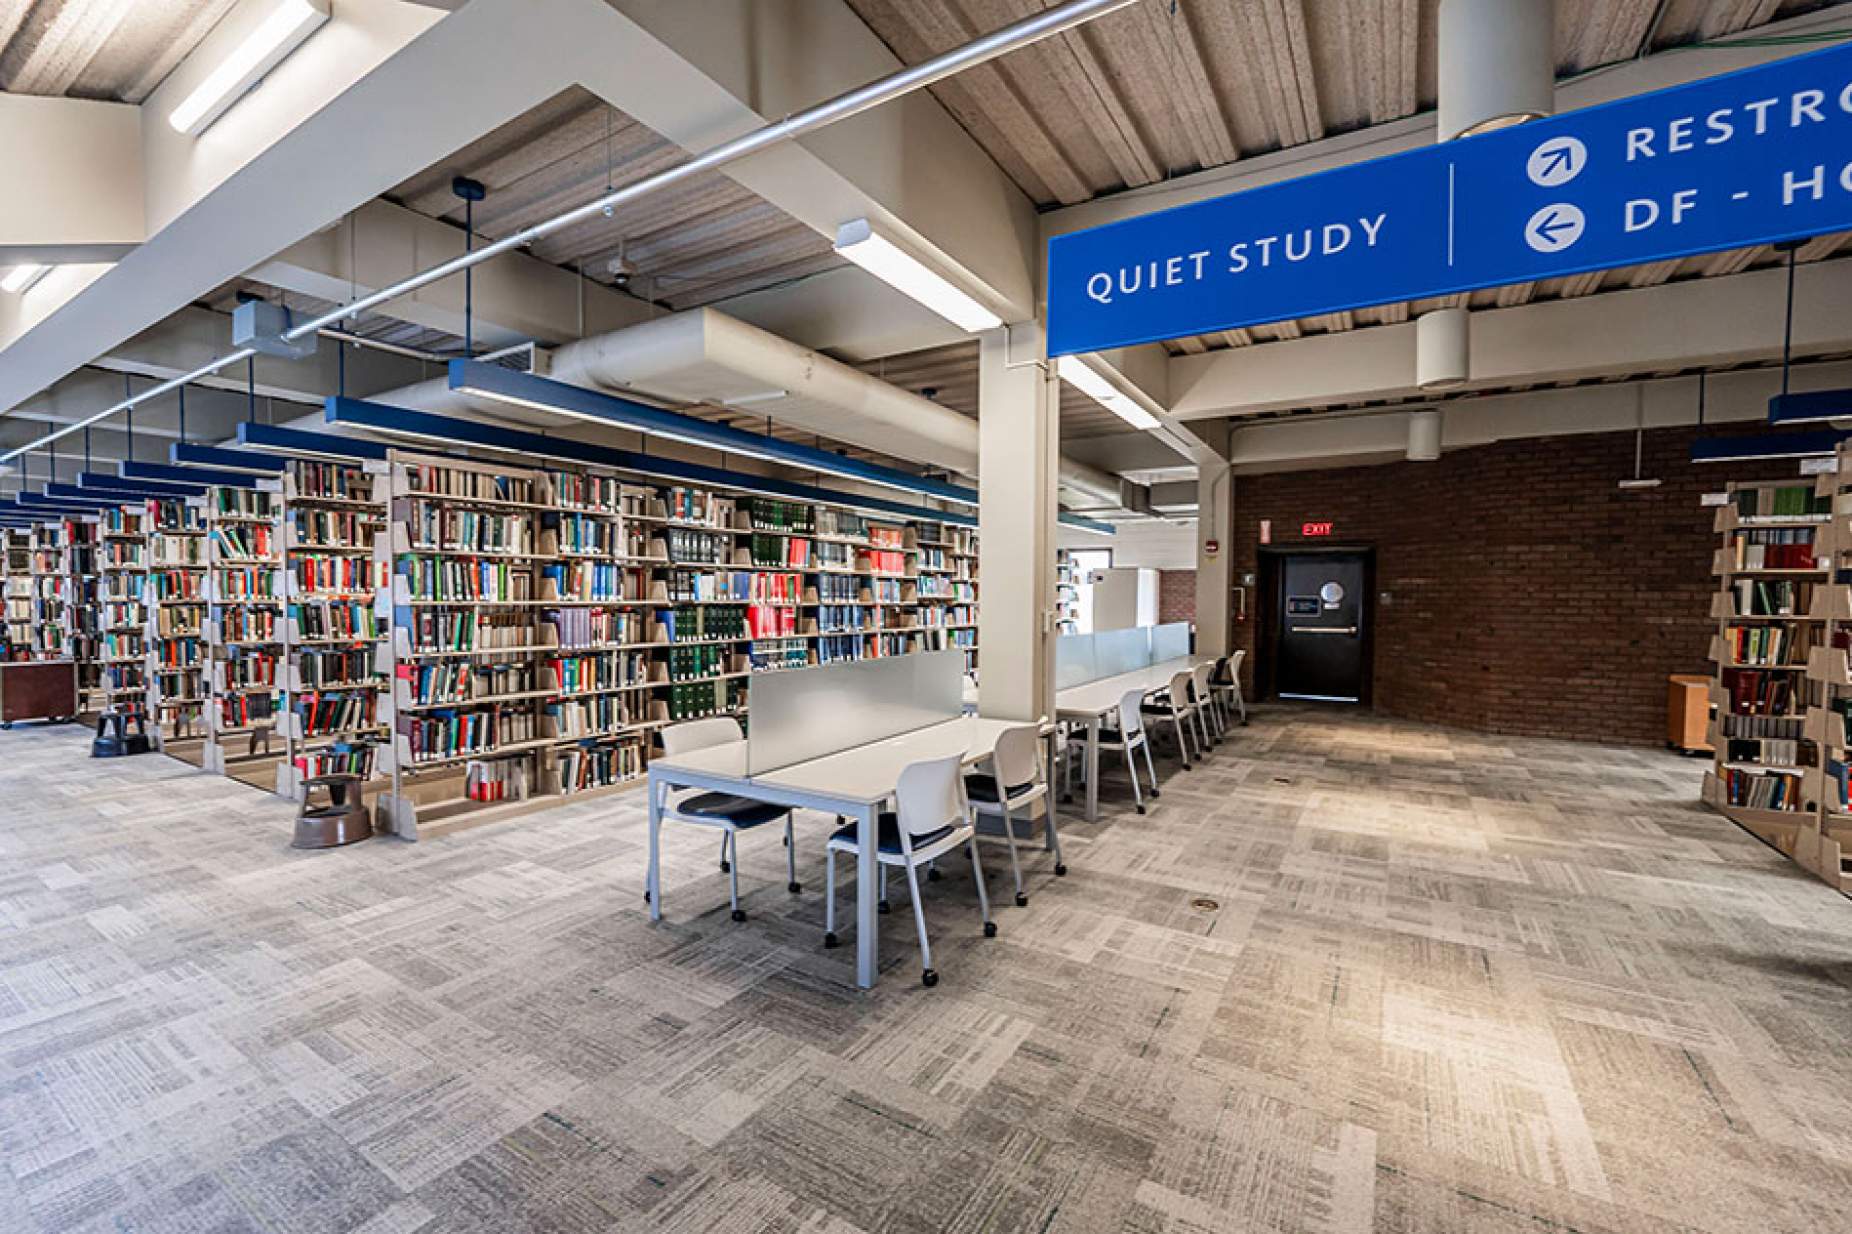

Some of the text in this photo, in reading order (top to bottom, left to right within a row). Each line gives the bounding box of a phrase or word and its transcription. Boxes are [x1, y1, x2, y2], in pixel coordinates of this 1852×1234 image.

[1625, 189, 1697, 232] DF
[1086, 214, 1386, 304] QUIET STUDY
[1302, 522, 1333, 536] EXIT
